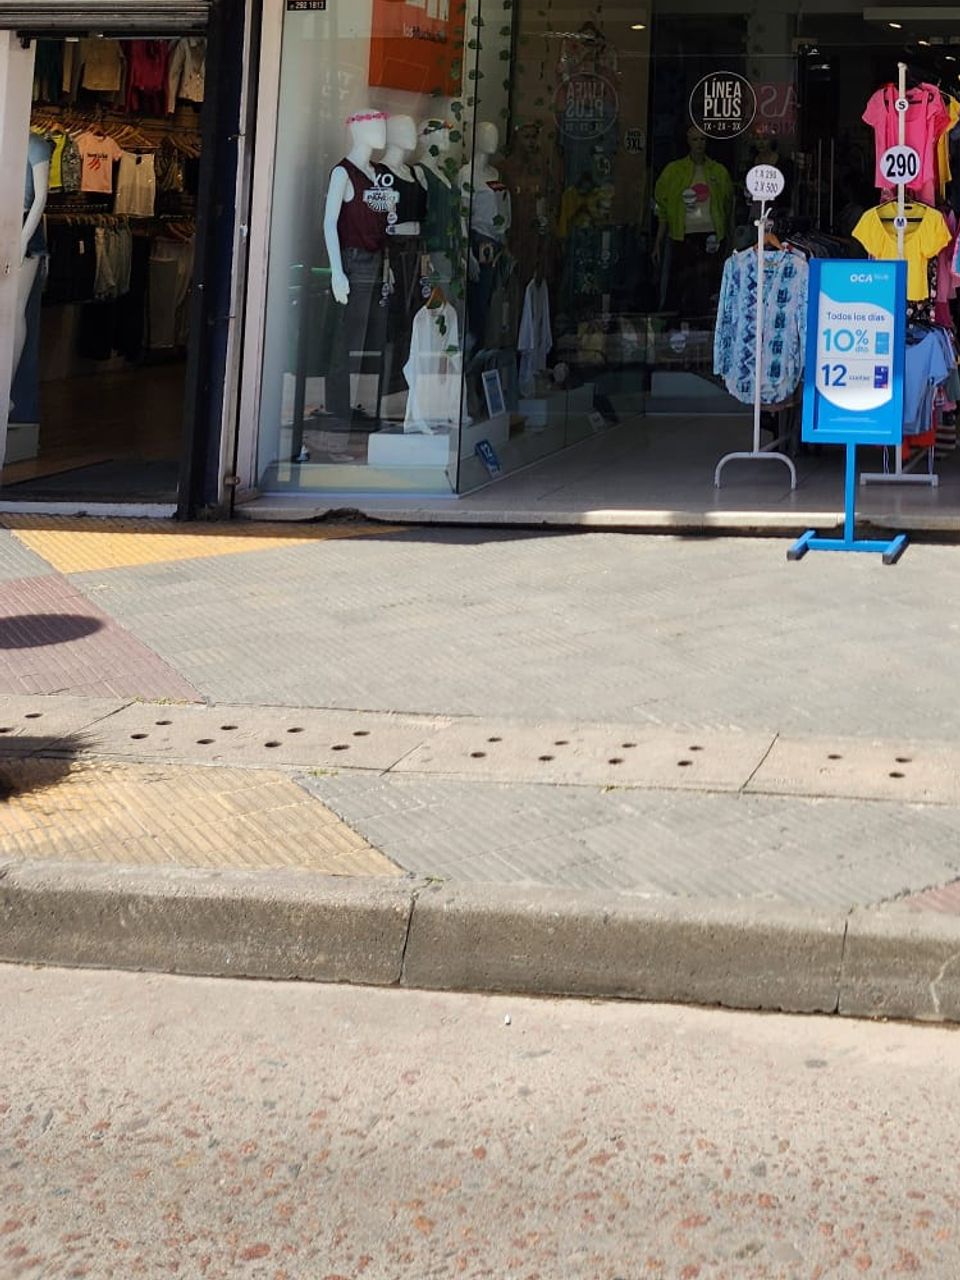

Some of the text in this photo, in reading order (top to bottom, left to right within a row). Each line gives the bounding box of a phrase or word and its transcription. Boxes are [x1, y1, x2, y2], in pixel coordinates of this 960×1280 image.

[704, 78, 743, 99] LÍNEA
[704, 99, 742, 117] PLUS
[898, 100, 906, 110] S
[886, 153, 917, 177] 290
[850, 274, 872, 283] OCA
[827, 312, 852, 321] Todos
[854, 312, 866, 321] los
[822, 364, 847, 387] 12
